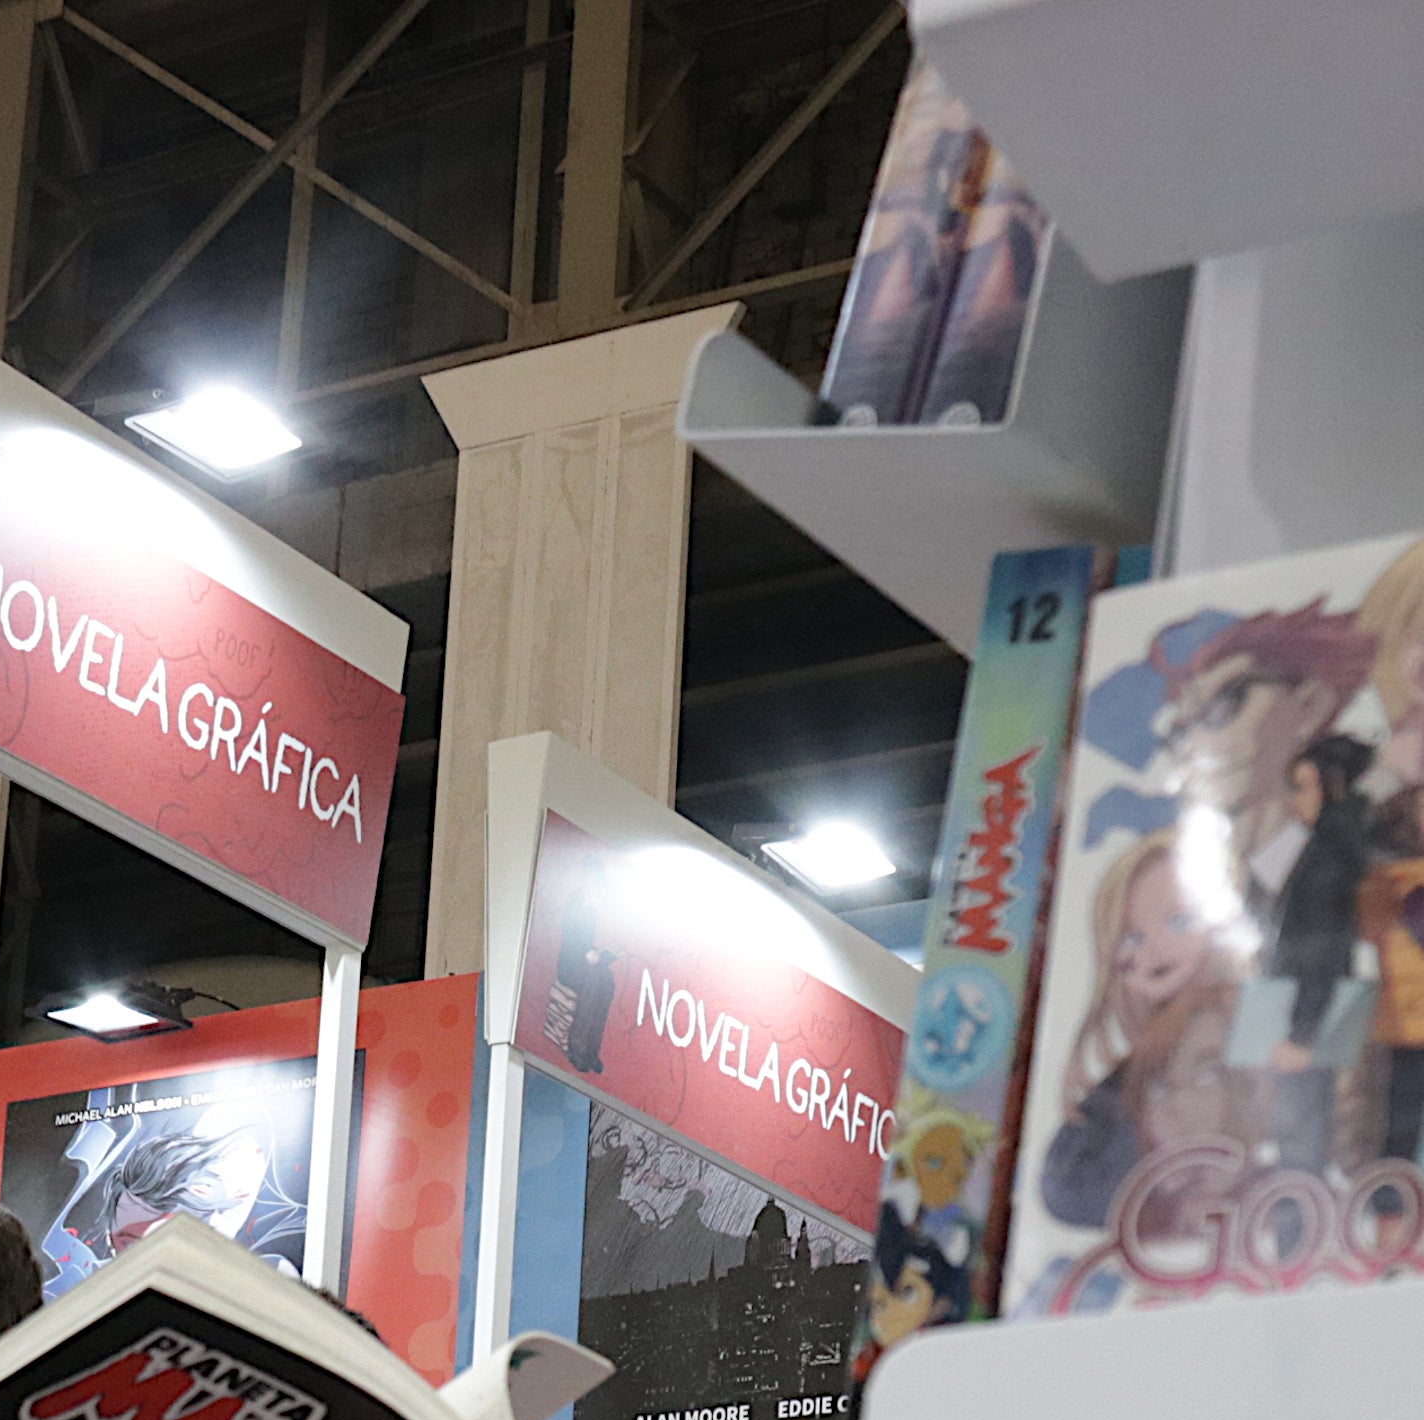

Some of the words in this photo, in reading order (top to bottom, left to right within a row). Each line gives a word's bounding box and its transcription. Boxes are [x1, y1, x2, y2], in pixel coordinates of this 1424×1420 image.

[1007, 591, 1063, 643] 12
[178, 682, 364, 844] GRÁFICA
[636, 968, 780, 1103] NOVELA
[55, 1108, 102, 1126] MICHAEL
[104, 1103, 133, 1118] ALAN
[134, 1097, 182, 1114] NELSON
[777, 1396, 833, 1419] EDDIE
